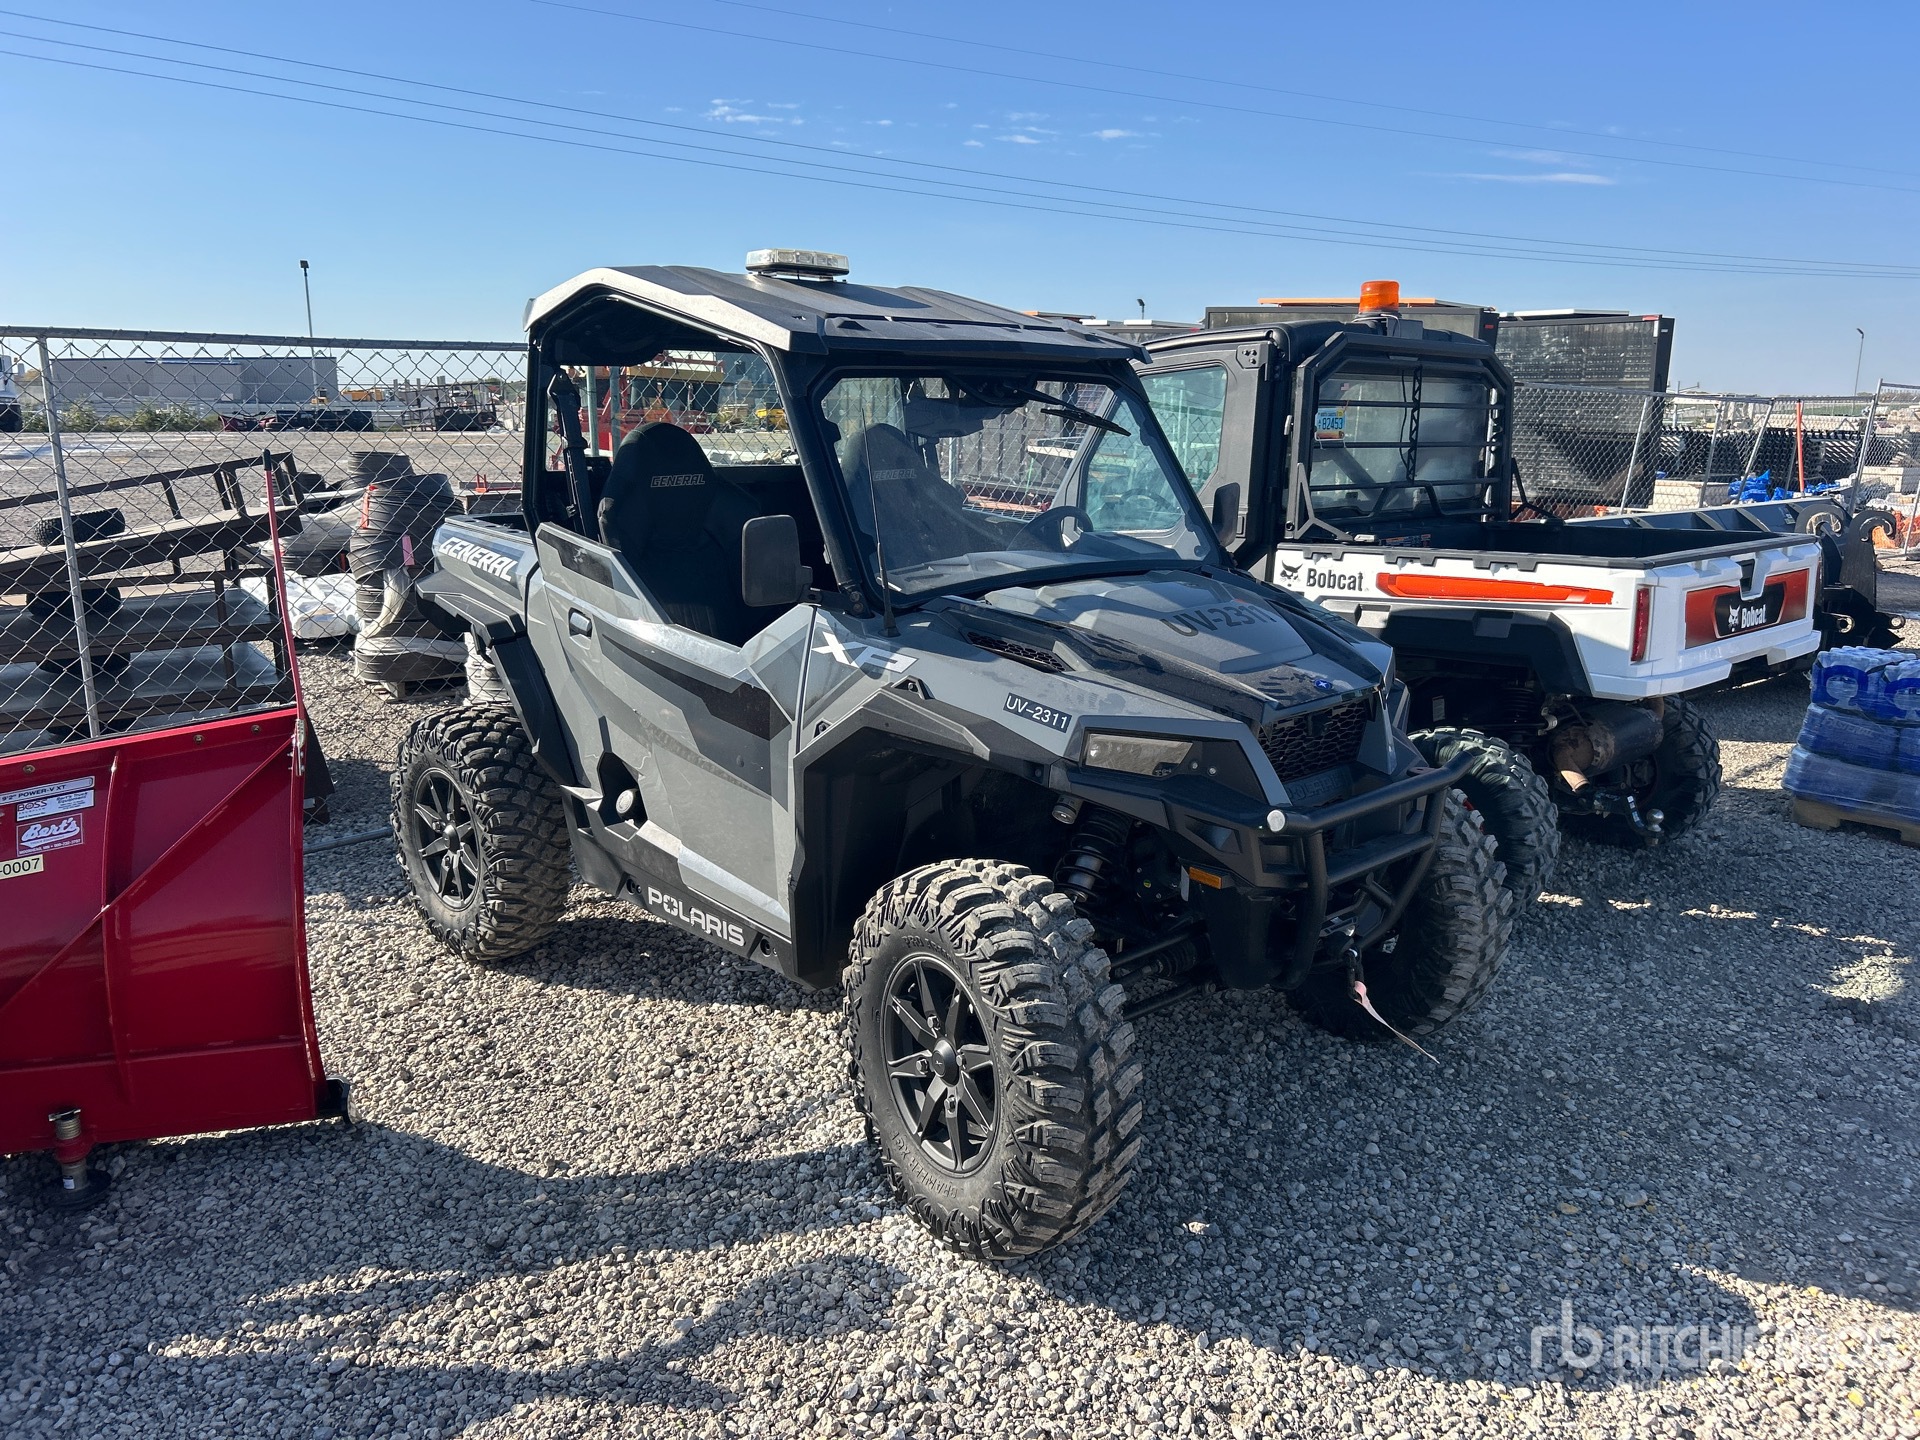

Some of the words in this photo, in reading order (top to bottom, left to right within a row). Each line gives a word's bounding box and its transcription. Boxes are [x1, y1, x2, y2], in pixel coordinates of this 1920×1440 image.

[1322, 418, 1344, 430] 82453
[650, 474, 706, 488] GENERAL
[873, 468, 917, 481] GENERAL
[439, 537, 519, 582] GENERAL
[1306, 568, 1363, 591] Bobcat
[1160, 604, 1277, 637] UV-2311
[1741, 604, 1767, 628] Bobcat
[1005, 694, 1069, 730] UV-2311
[18, 787, 55, 798] POWER-V
[17, 800, 47, 811] BOSS
[21, 817, 77, 841] Bert's
[647, 886, 747, 947] POLARIS
